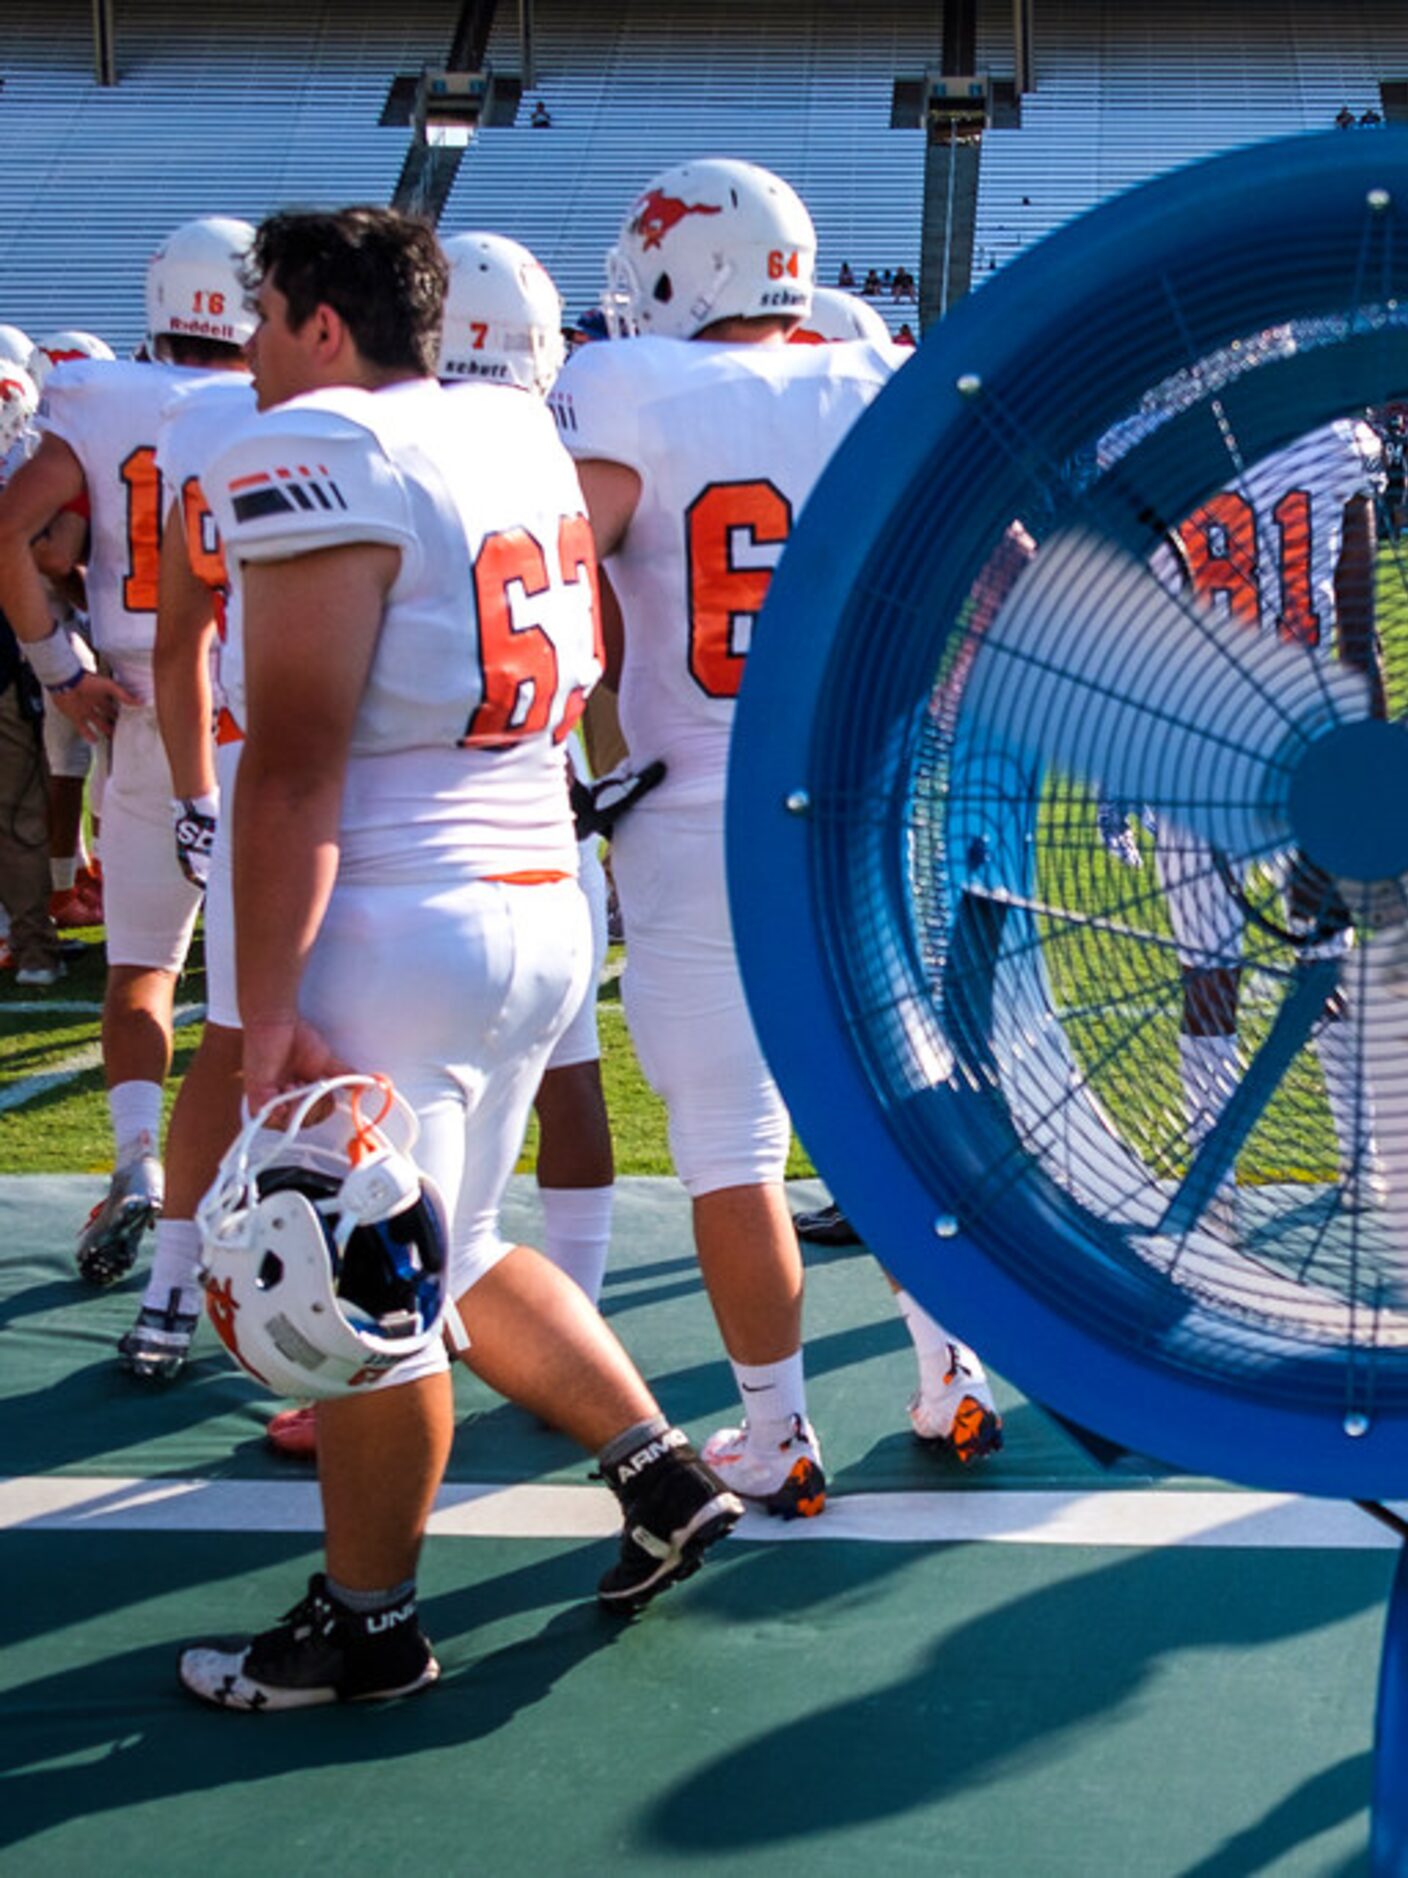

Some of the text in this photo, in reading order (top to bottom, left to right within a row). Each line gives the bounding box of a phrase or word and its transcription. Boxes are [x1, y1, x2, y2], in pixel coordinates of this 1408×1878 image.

[767, 249, 799, 281] 64
[191, 290, 225, 316] 16
[469, 320, 489, 351] 7
[119, 445, 163, 612] 1
[685, 479, 793, 699] 6
